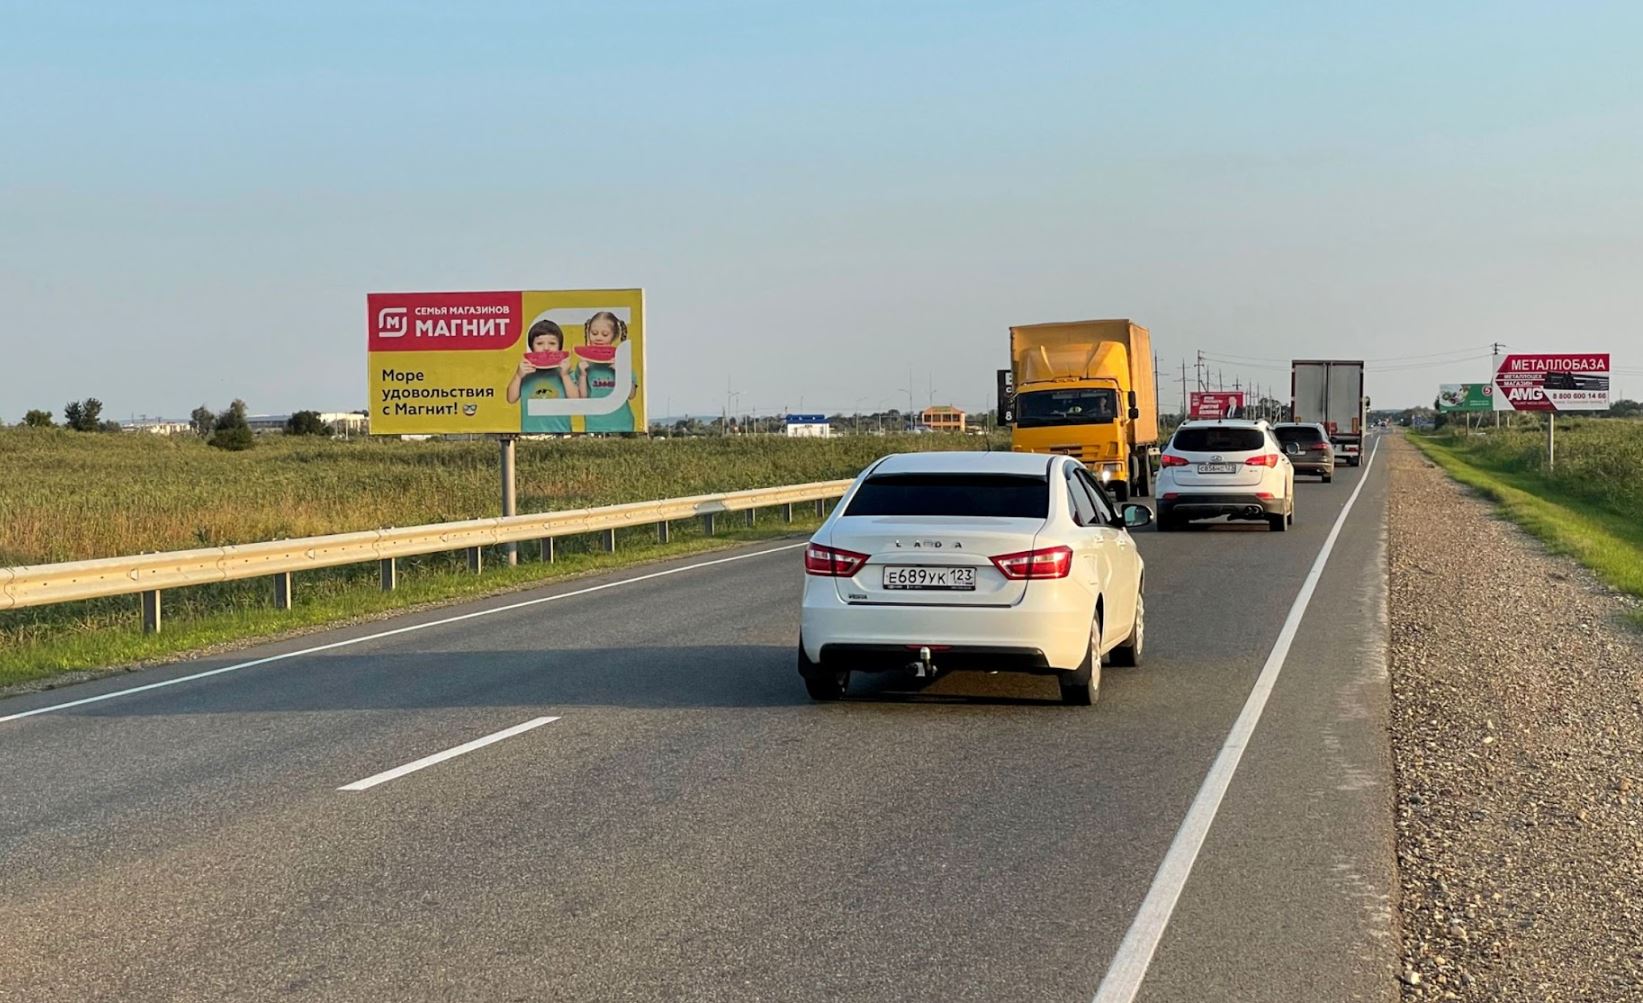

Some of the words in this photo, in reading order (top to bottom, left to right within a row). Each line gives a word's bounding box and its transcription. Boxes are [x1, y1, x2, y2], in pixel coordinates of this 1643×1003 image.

[415, 307, 447, 315] СЕМЬЯ
[449, 306, 510, 315] МАГАЗИНОВ
[415, 318, 510, 337] МАГНИТ
[1511, 359, 1606, 370] МЕТАЛЛОБАЗА
[382, 369, 424, 384] Море
[382, 388, 494, 402] удовольствия
[1508, 387, 1544, 401] AMG
[382, 406, 390, 415] с
[395, 402, 458, 415] Магнит!
[895, 540, 963, 549] LADA
[889, 569, 946, 584] Е689УК
[950, 569, 972, 581] 123
